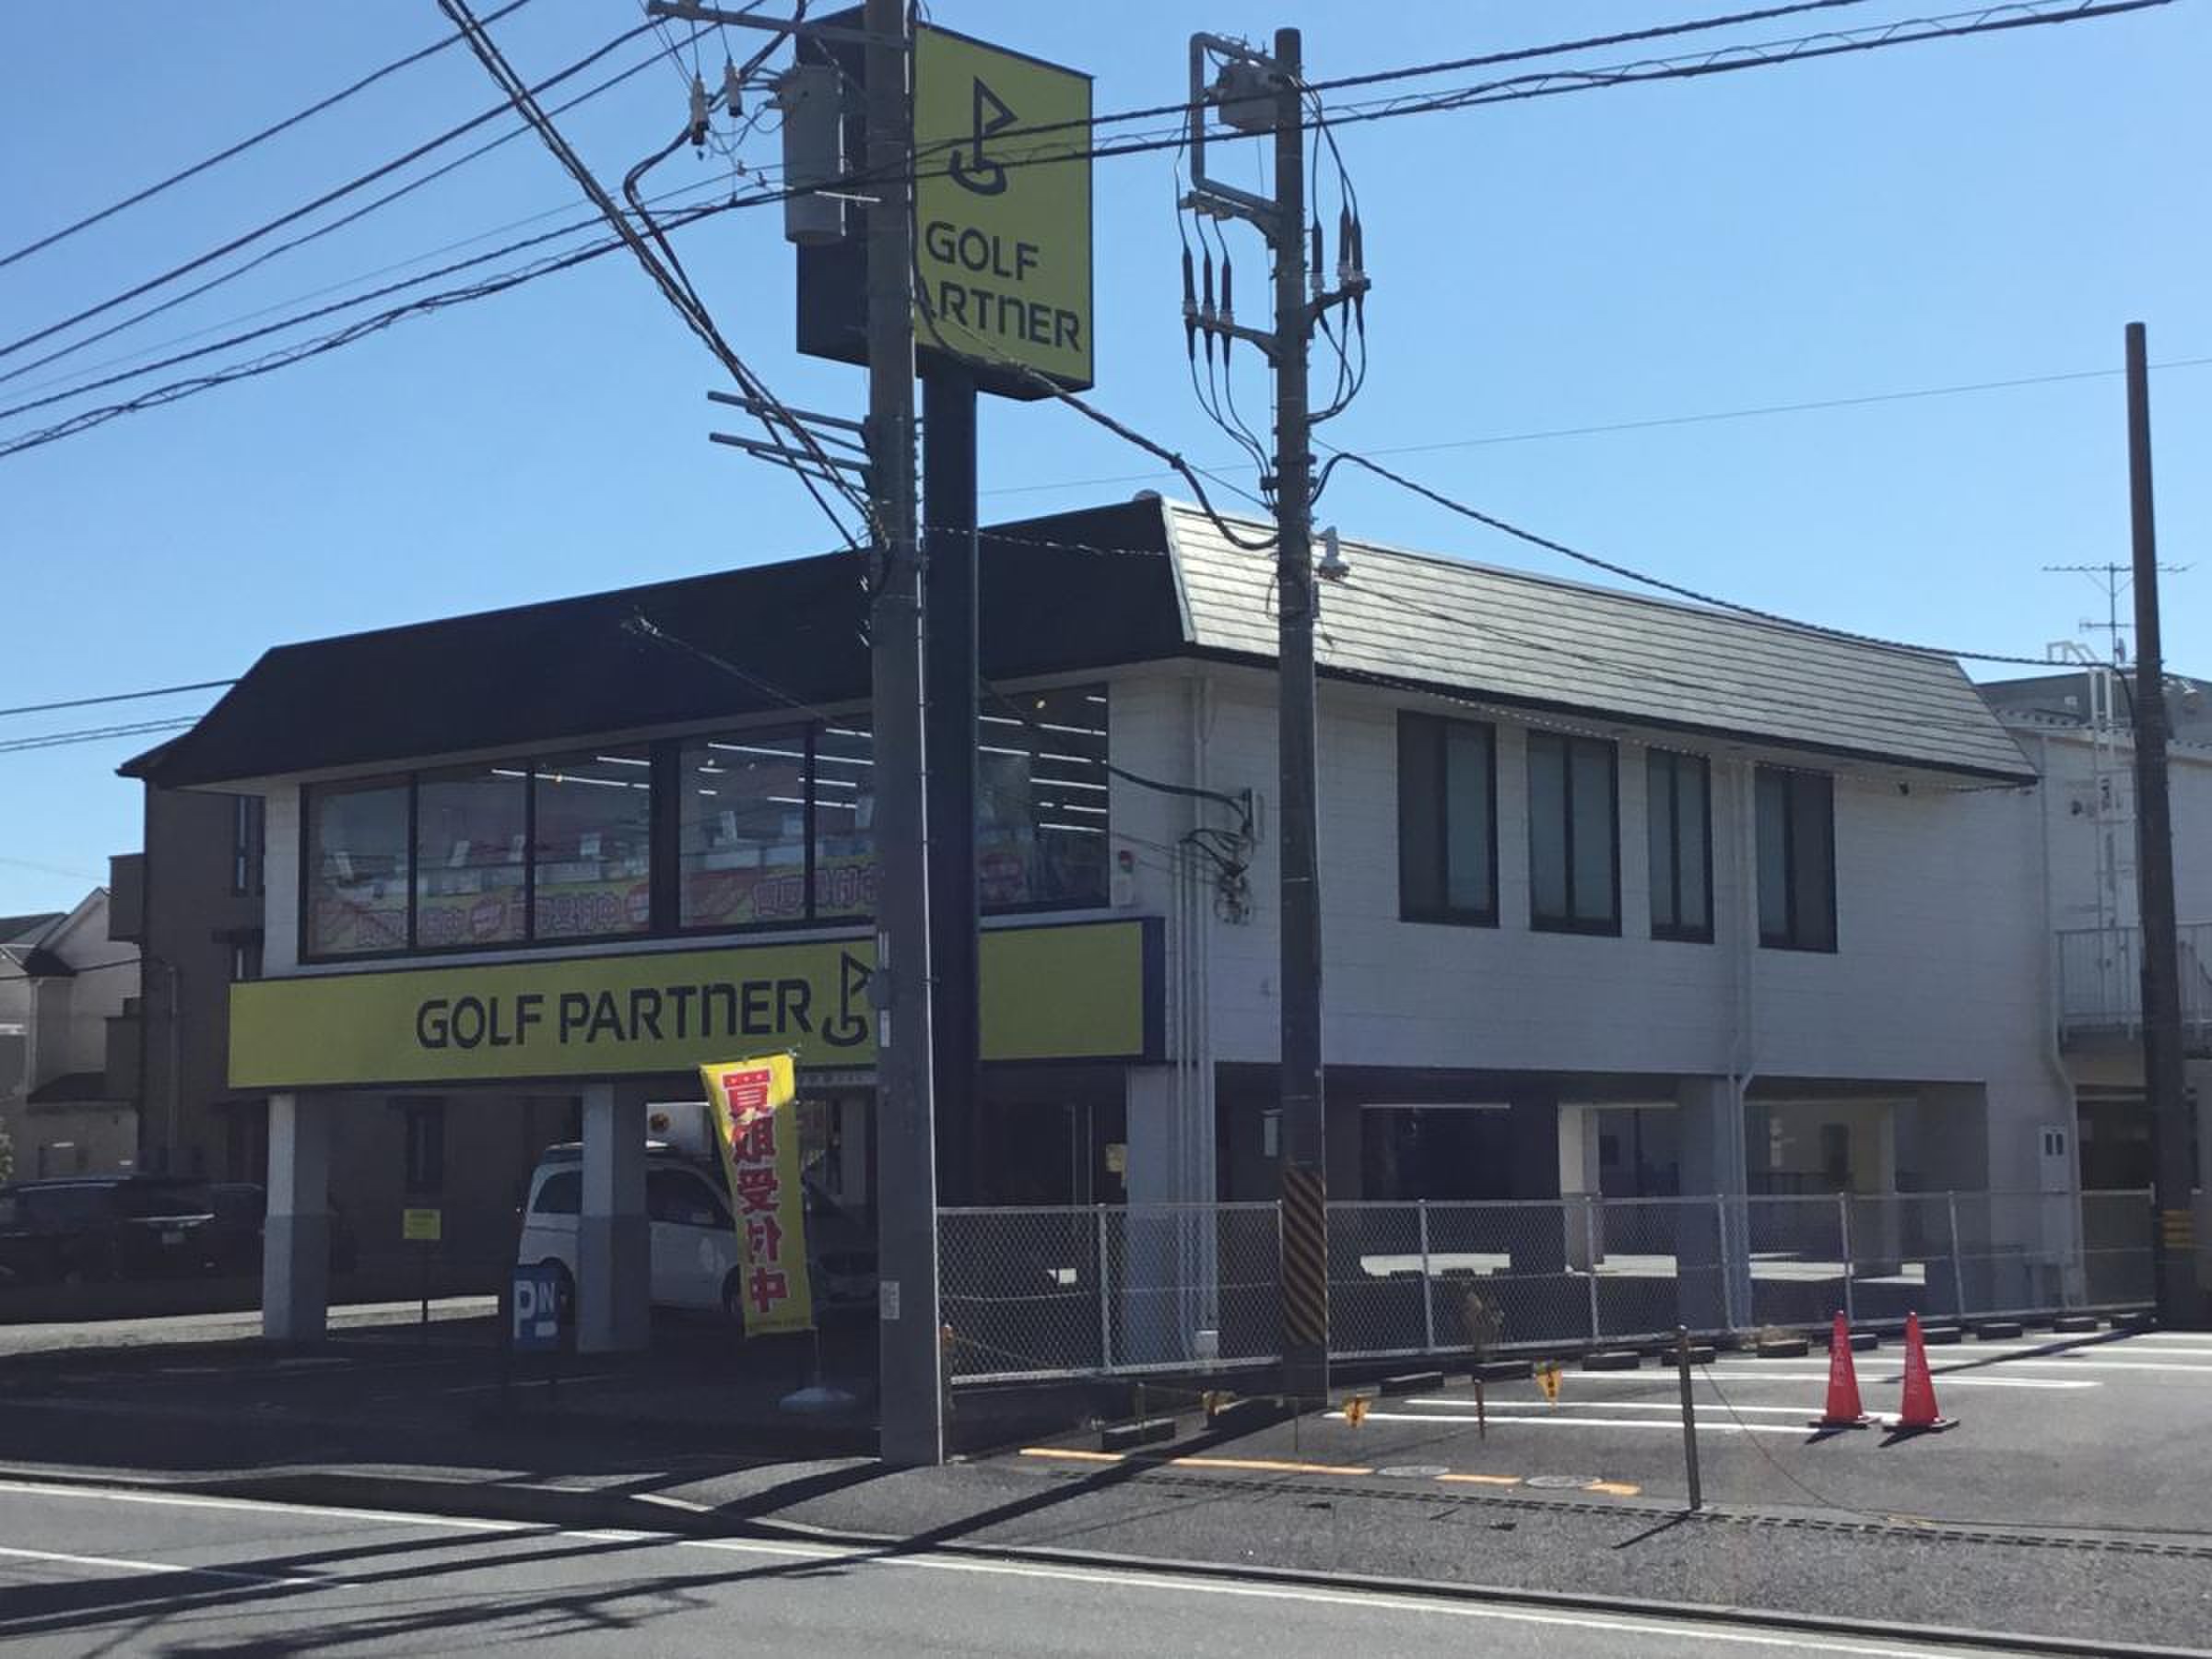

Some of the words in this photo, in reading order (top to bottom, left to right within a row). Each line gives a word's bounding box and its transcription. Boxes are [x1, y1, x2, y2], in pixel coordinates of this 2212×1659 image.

[926, 221, 1039, 280] GOLF
[920, 279, 1081, 352] RTNER
[417, 994, 544, 1049] GOLF
[559, 978, 813, 1044] PARTNER
